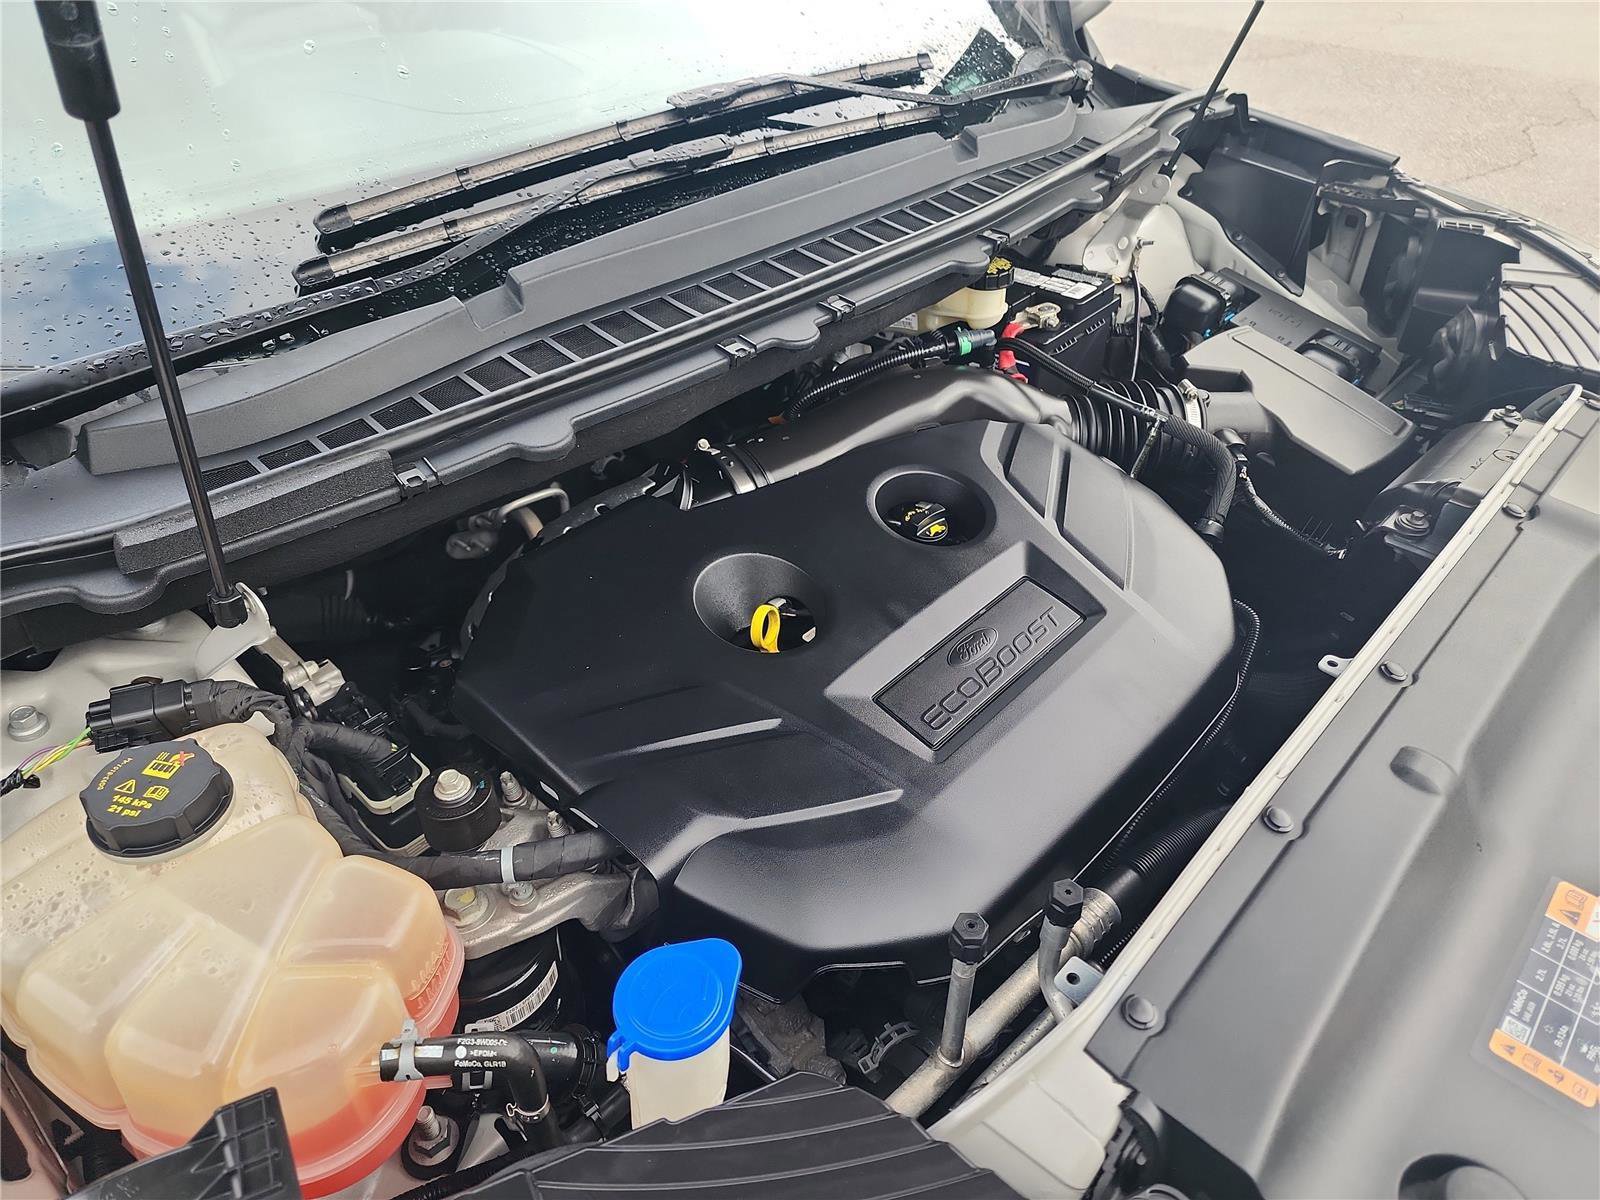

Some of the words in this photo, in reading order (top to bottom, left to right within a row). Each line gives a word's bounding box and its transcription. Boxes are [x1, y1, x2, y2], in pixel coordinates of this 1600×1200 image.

[956, 632, 992, 662] Ford
[920, 606, 1059, 731] ECOBOOST
[107, 804, 123, 813] 21
[121, 808, 142, 817] psi
[112, 794, 132, 805] 145
[132, 798, 153, 809] kPa
